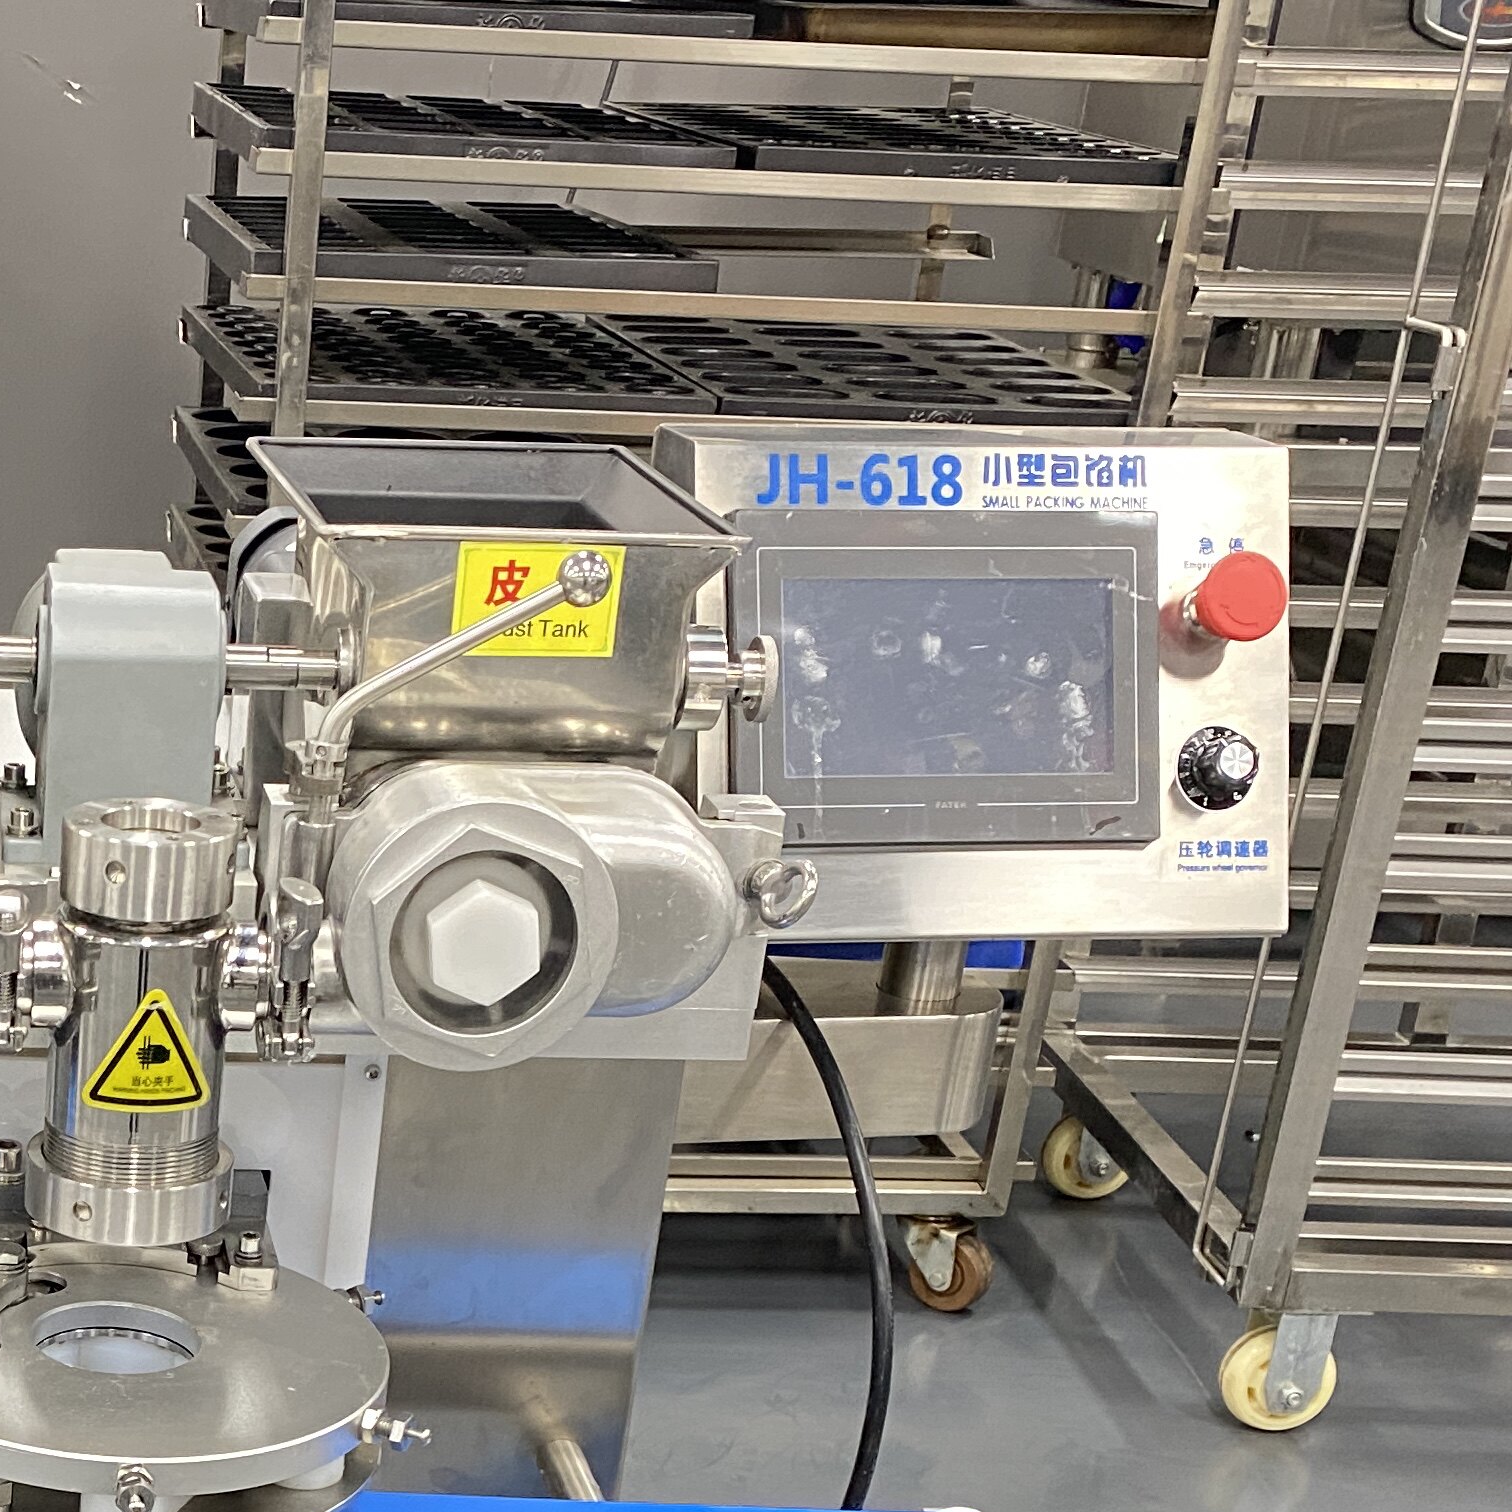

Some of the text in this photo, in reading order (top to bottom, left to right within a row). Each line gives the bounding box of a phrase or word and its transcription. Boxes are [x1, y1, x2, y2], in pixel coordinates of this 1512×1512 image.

[982, 453, 1147, 487] 小型包馅机
[756, 452, 963, 507] JH-618
[981, 495, 1148, 510] SMALL PACKING MACHINE
[539, 619, 589, 638] Tank
[1178, 840, 1268, 858] 压轮调速器
[131, 1075, 174, 1087] 当心夹手
